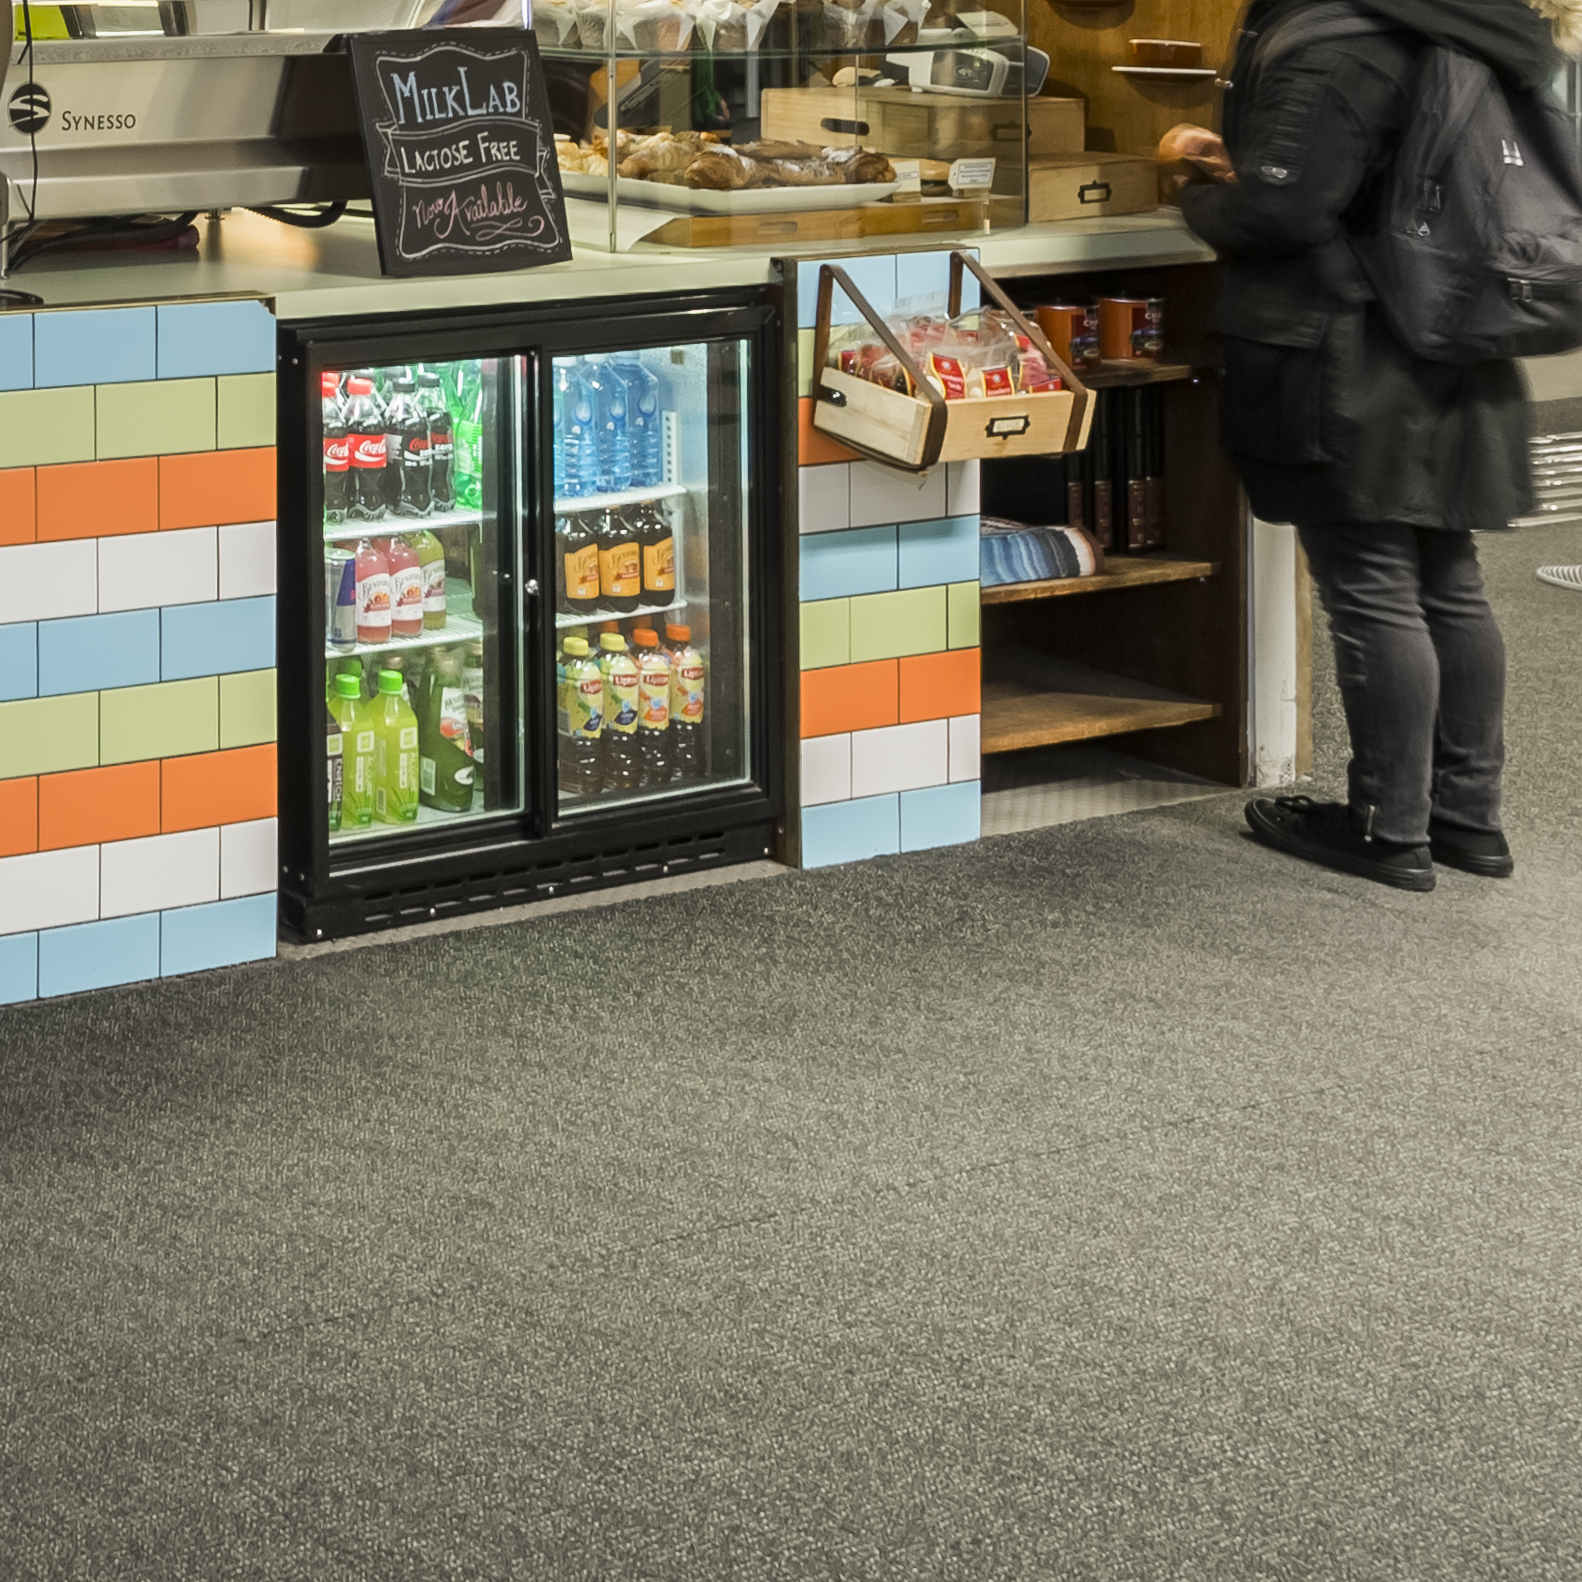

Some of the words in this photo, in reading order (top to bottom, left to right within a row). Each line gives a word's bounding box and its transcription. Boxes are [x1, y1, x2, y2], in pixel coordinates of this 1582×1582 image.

[61, 110, 136, 131] SYNESSO
[401, 140, 473, 173] LACTOSE
[477, 131, 521, 162] FREE
